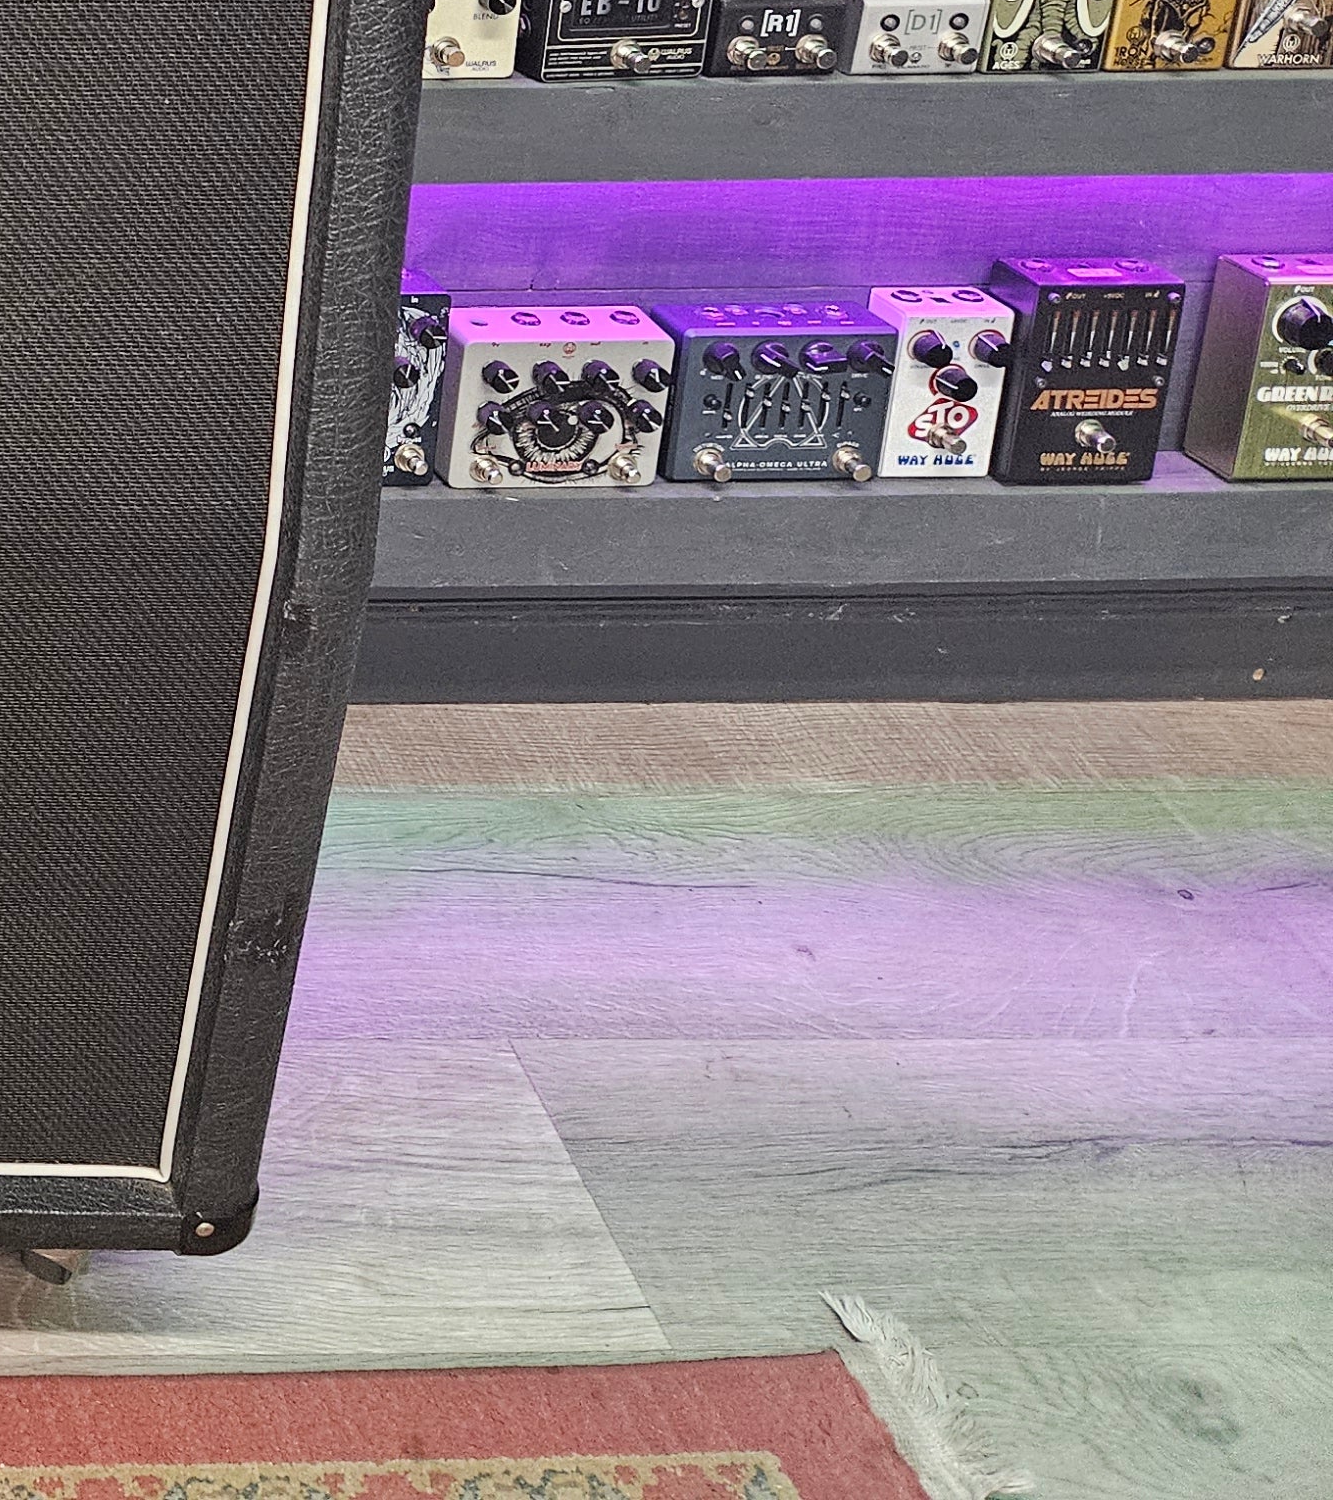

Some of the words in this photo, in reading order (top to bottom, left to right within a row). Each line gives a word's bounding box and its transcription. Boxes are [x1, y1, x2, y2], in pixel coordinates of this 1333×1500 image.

[473, 12, 499, 21] BLEND
[760, 8, 802, 37] [R1]
[904, 8, 943, 35] [D1]
[1113, 46, 1149, 57] IRON
[991, 61, 1021, 70] AGES
[1257, 53, 1322, 65] WARHORN
[1030, 388, 1160, 411] ATREIDES
[1257, 385, 1318, 403] GREEN
[897, 454, 927, 467] WAY
[937, 453, 974, 465] HUGE
[1039, 452, 1074, 467] WAY
[1079, 451, 1129, 466] HUGE
[1264, 447, 1302, 463] WAY
[525, 460, 584, 472] LUMINARY
[796, 460, 828, 468] ULTRA
